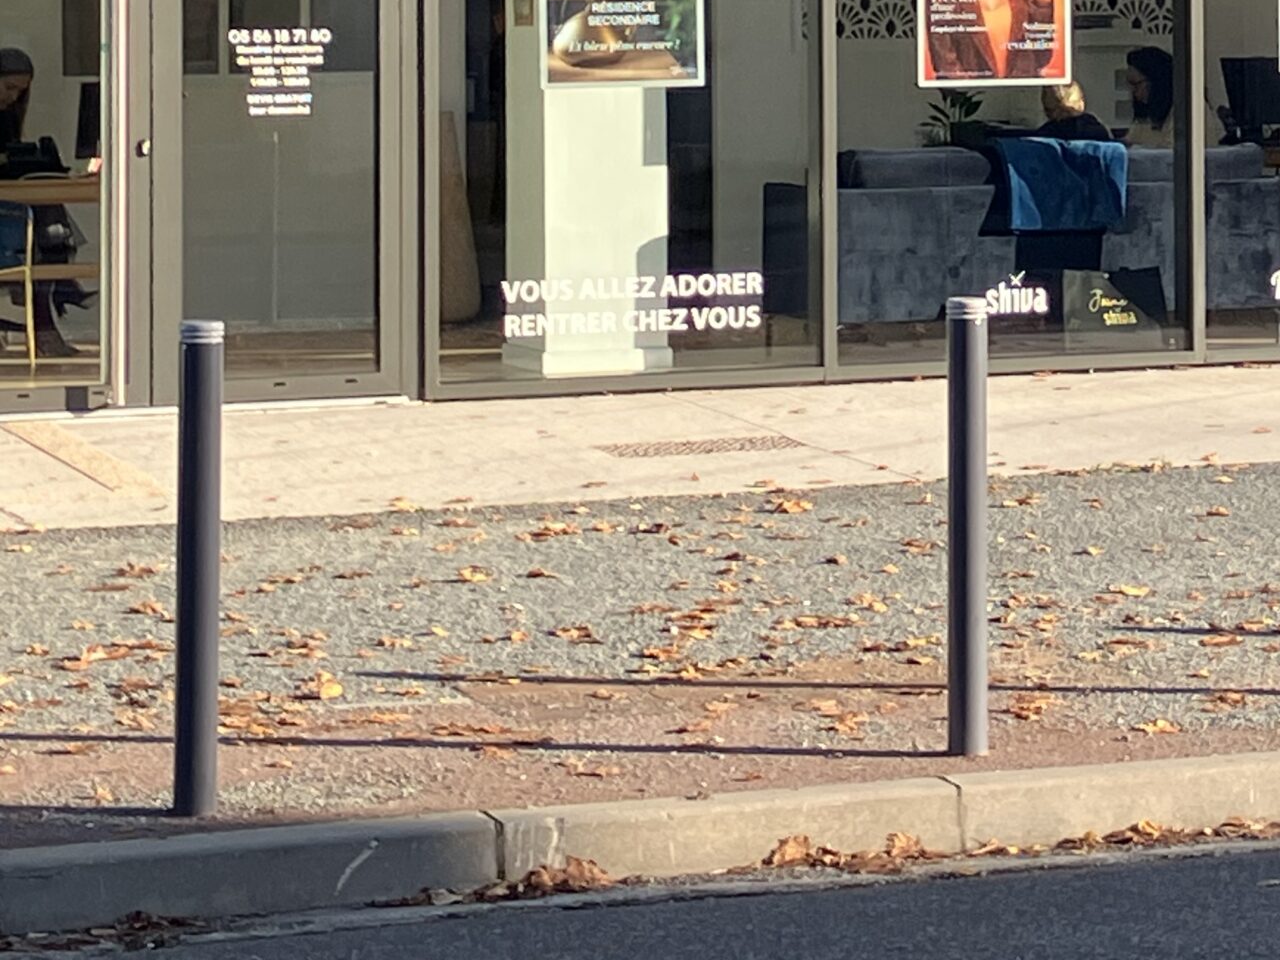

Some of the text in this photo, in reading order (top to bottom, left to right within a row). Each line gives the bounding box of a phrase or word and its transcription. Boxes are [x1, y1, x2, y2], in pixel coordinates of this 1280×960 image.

[588, 13, 660, 26] SECONDAIRE
[591, 0, 656, 13] RÉSIDENCE
[502, 272, 763, 303] VOUS ALLEZ ADORER
[986, 271, 1048, 314] shiva
[505, 306, 762, 337] RENTRER CHEZ VOUS
